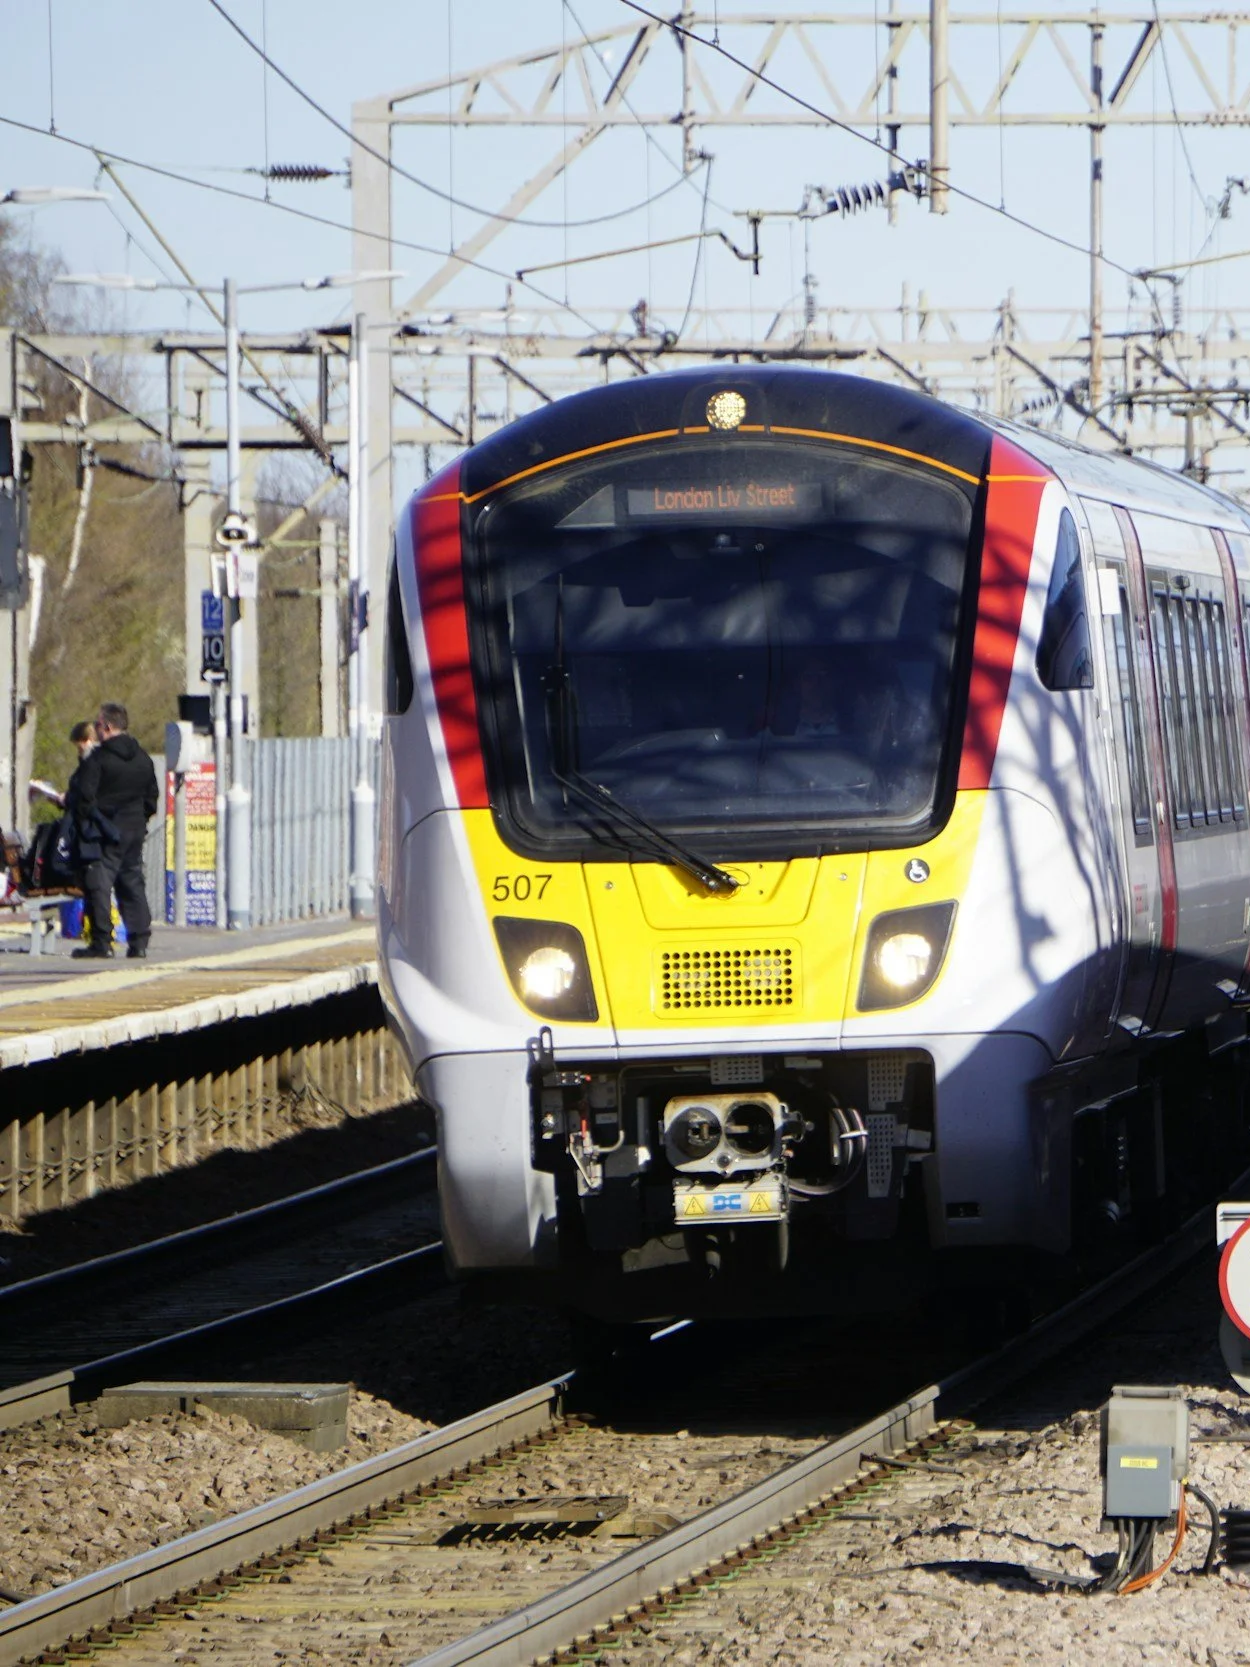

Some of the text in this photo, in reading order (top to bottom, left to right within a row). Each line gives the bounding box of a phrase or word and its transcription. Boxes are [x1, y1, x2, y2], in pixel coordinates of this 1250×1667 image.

[654, 482, 796, 510] London Liv Street
[203, 597, 221, 620] 12
[204, 637, 224, 660] 10
[492, 874, 552, 901] 507
